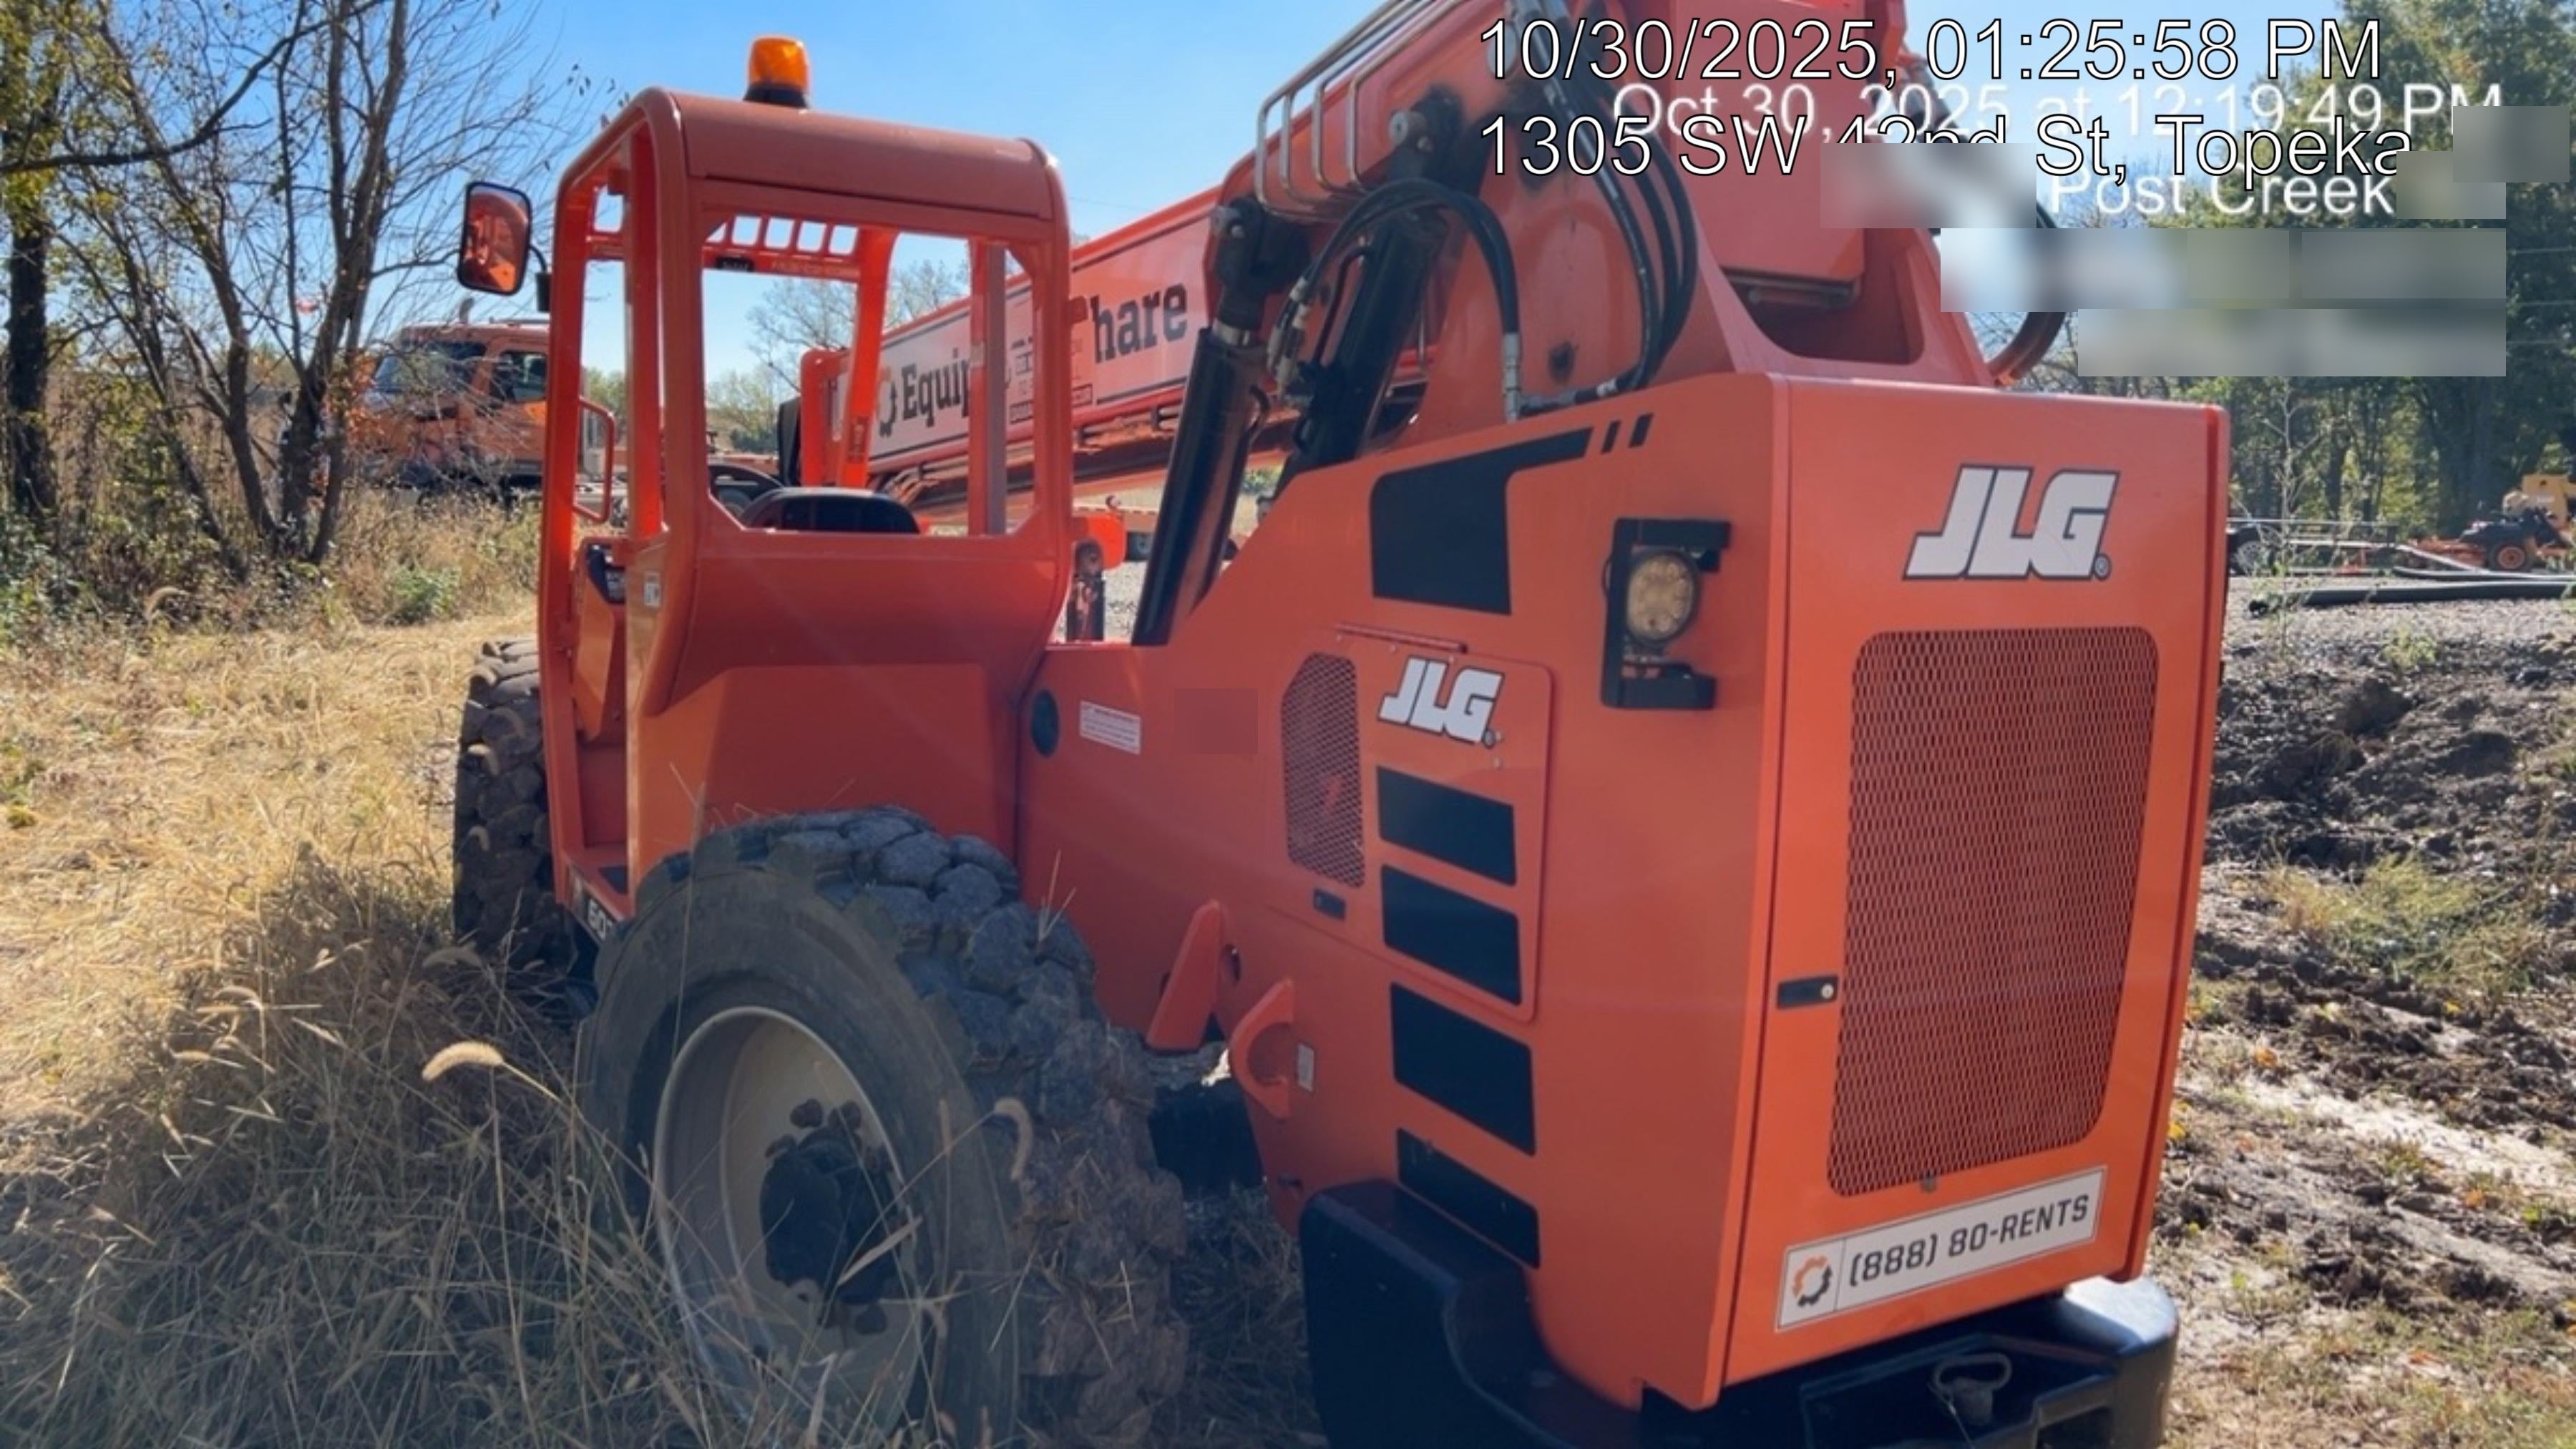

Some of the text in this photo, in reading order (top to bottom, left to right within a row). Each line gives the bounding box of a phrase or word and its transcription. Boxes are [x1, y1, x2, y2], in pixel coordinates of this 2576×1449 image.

[1901, 463, 2121, 581] JLG
[1377, 654, 1506, 748] JLG
[1849, 1194, 2089, 1287] (888) 80-RENTS
